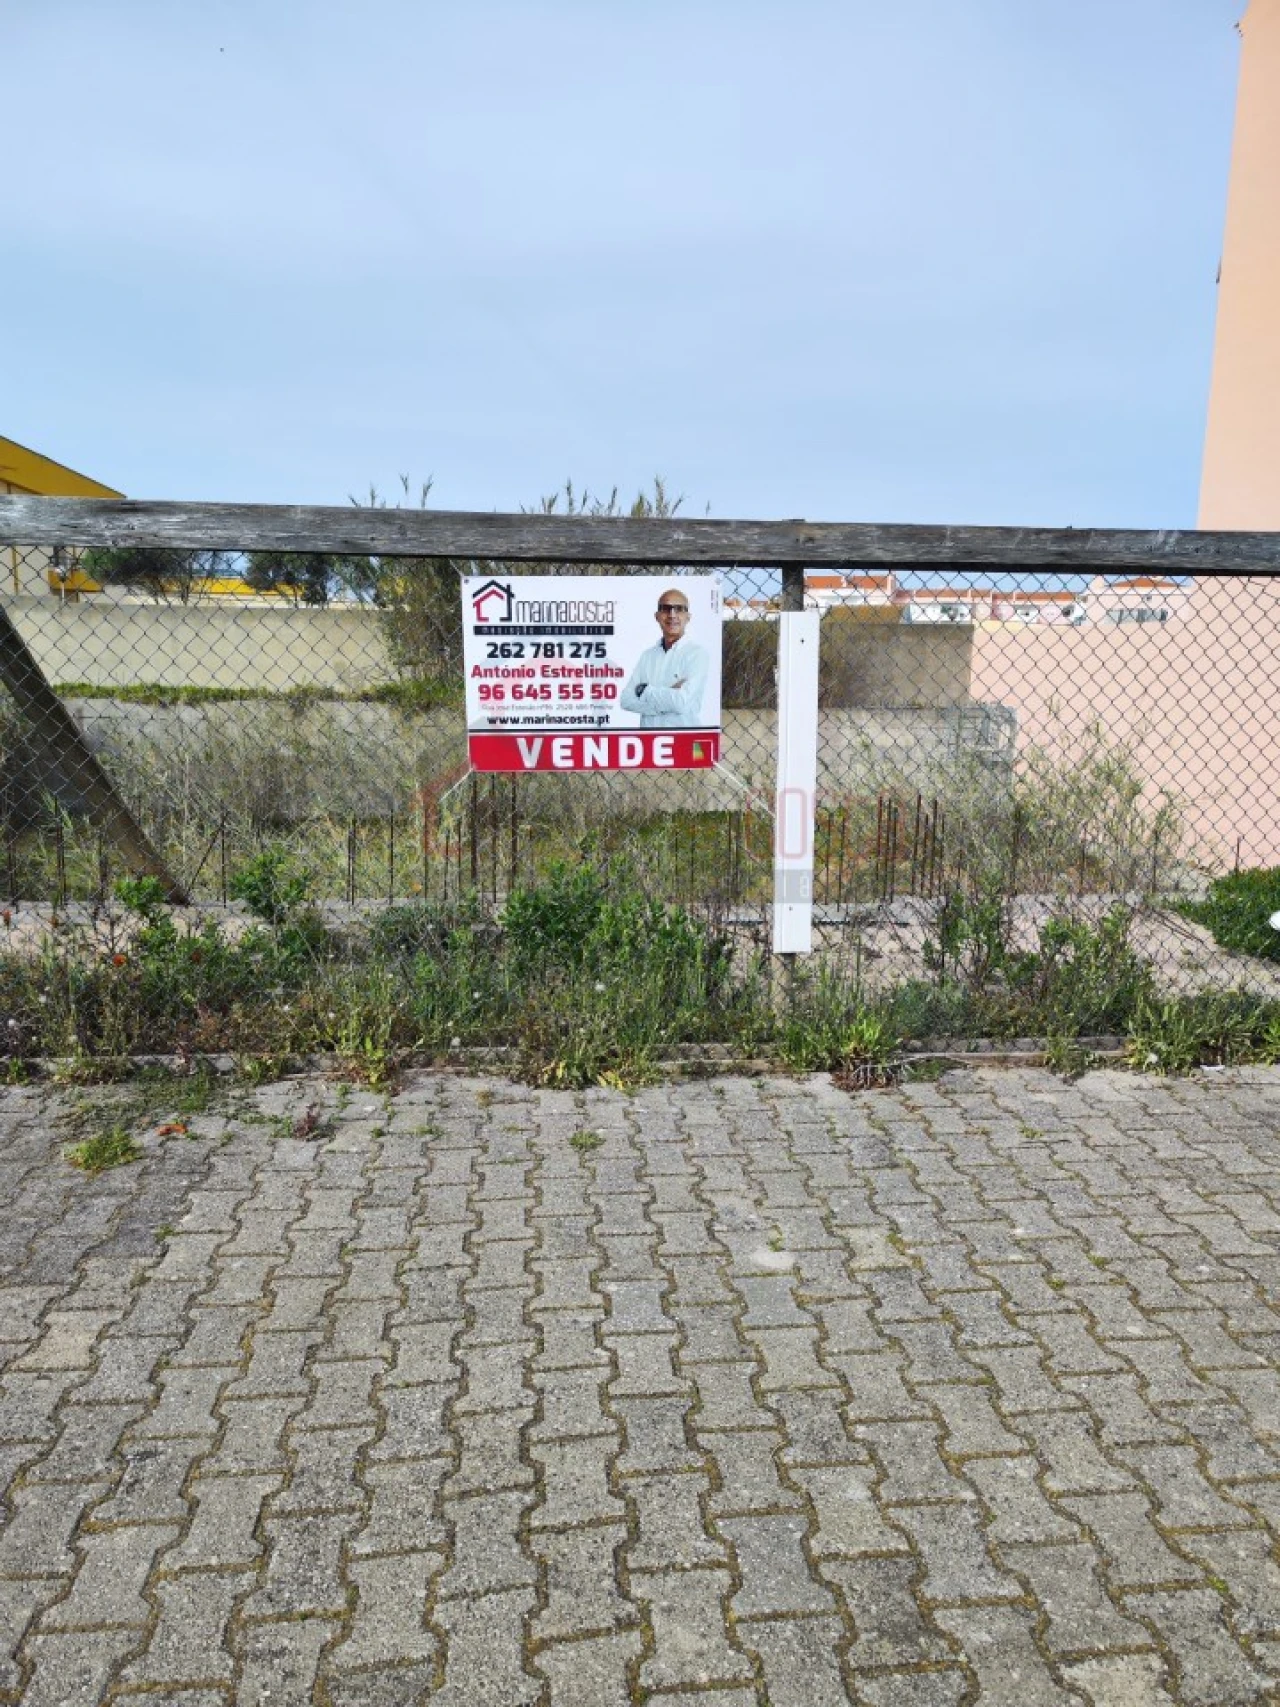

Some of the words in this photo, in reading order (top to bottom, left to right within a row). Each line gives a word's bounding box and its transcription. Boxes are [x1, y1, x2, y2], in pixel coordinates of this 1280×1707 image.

[486, 641, 525, 659] 262
[530, 641, 564, 659] 781
[569, 641, 607, 659] 275
[471, 664, 536, 678] António
[541, 662, 625, 679] Estrelinha
[478, 684, 505, 700] 96
[511, 684, 552, 700] 645
[558, 684, 584, 700] 55
[590, 684, 618, 700] 50
[487, 713, 611, 728] www.marinacosta.pt
[516, 736, 675, 769] VENDE
